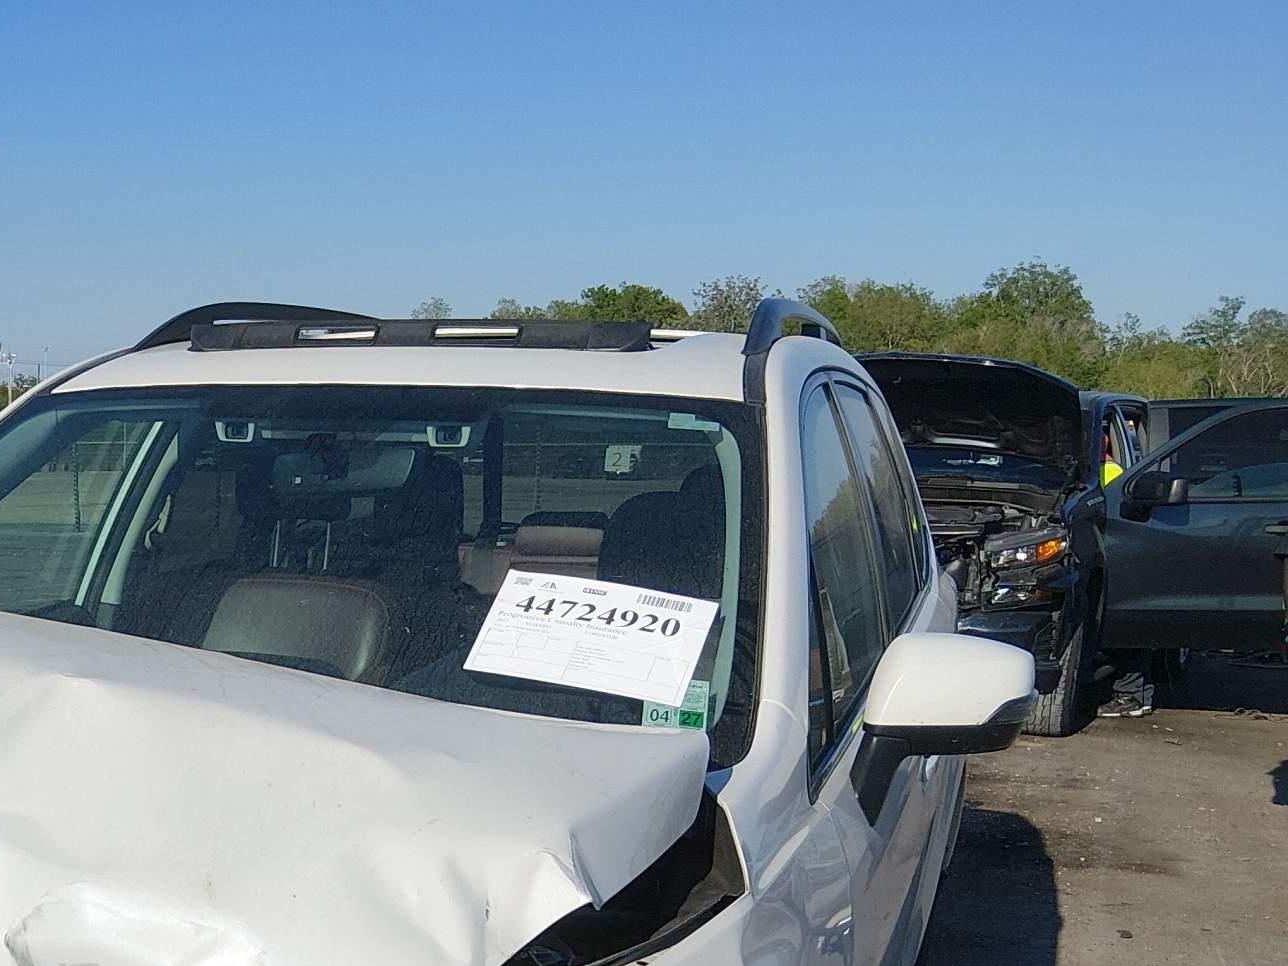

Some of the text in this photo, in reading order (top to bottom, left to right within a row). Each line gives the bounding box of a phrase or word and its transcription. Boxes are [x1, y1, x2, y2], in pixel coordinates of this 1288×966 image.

[612, 452, 623, 467] 2
[515, 595, 681, 637] 44724920
[649, 708, 670, 723] 04
[681, 711, 702, 726] 27
